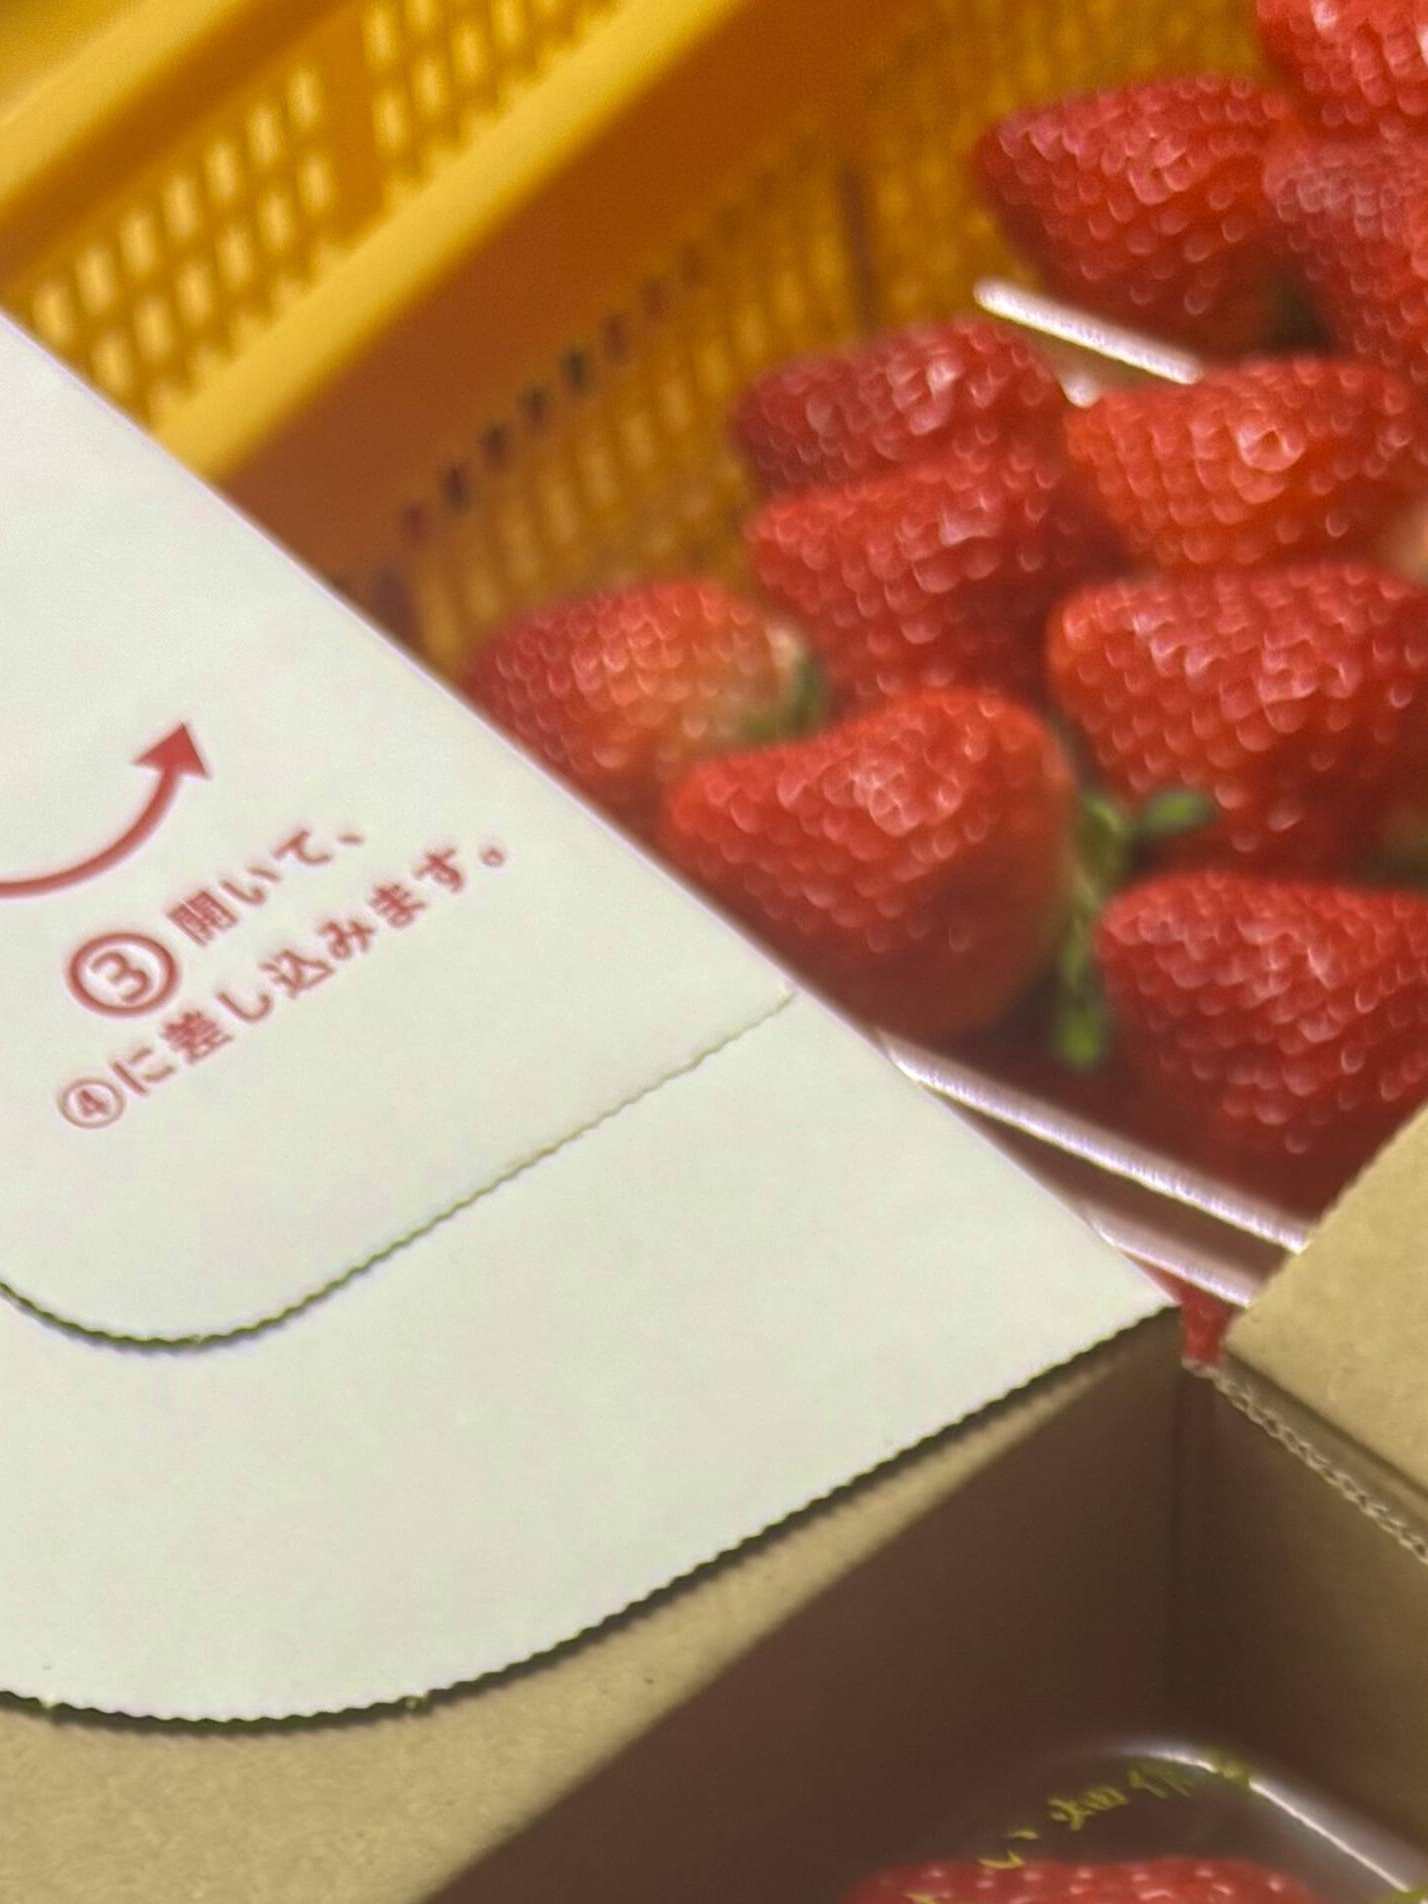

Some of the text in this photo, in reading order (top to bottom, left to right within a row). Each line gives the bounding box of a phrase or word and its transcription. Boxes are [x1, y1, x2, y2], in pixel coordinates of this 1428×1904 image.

[55, 845, 509, 1130] ④に差し込みます。
